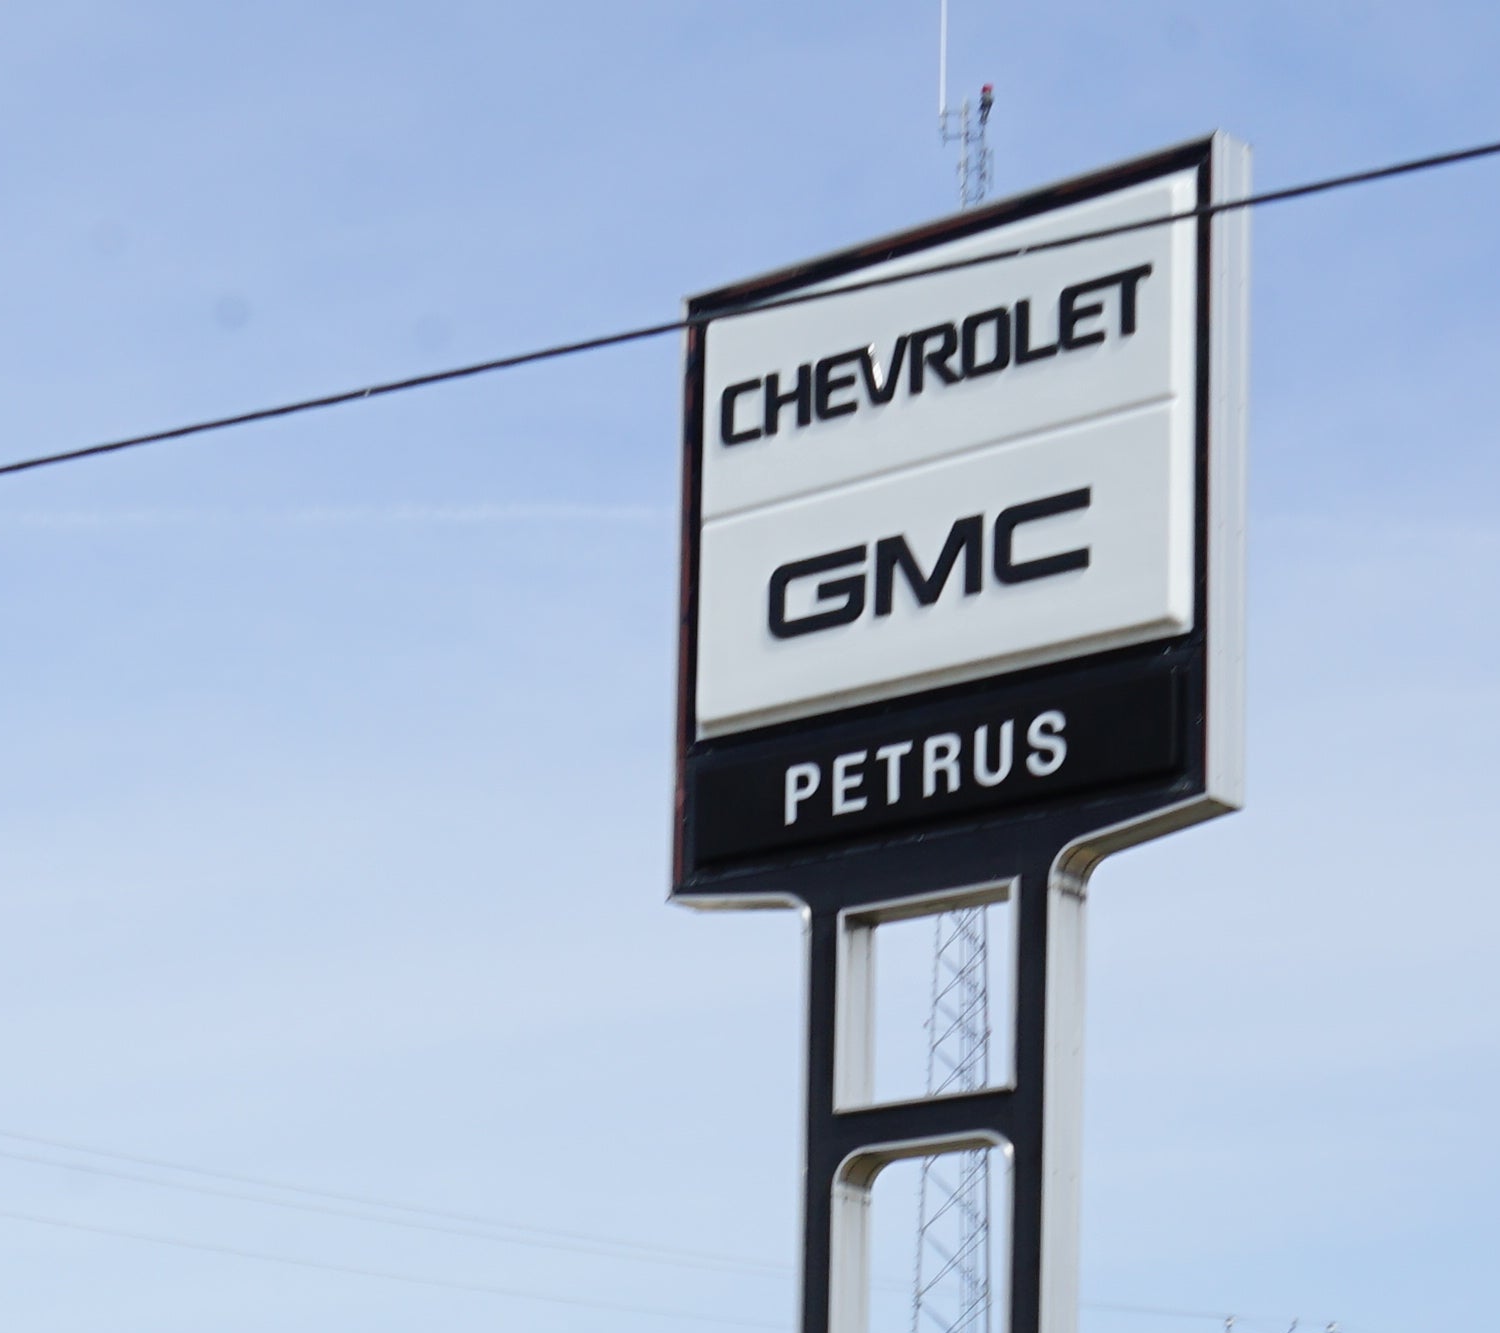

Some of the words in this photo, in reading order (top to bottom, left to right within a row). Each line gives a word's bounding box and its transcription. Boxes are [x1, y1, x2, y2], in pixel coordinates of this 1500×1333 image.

[721, 263, 1153, 447] CHEVROLET
[767, 486, 1092, 639] GMC
[784, 710, 1069, 826] PETRUS
